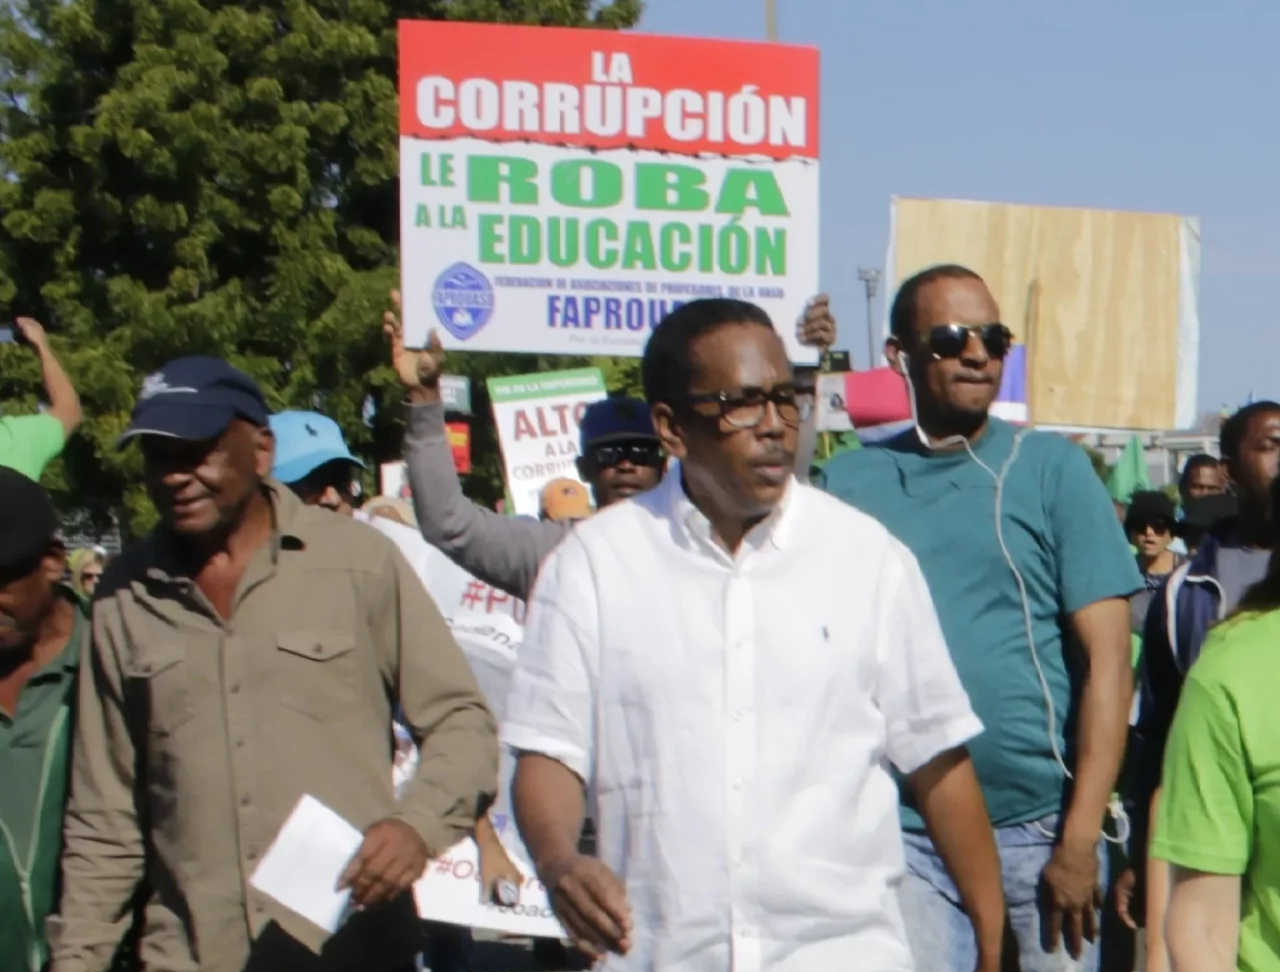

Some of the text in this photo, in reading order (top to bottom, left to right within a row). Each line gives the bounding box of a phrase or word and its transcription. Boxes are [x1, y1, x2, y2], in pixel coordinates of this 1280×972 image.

[591, 51, 633, 83] LA
[416, 75, 807, 147] CORRUPCIÓN
[420, 152, 791, 217] LE ROBA
[415, 204, 468, 229] A LA
[478, 214, 787, 276] EDUCACIÓN
[545, 440, 577, 458] A LA
